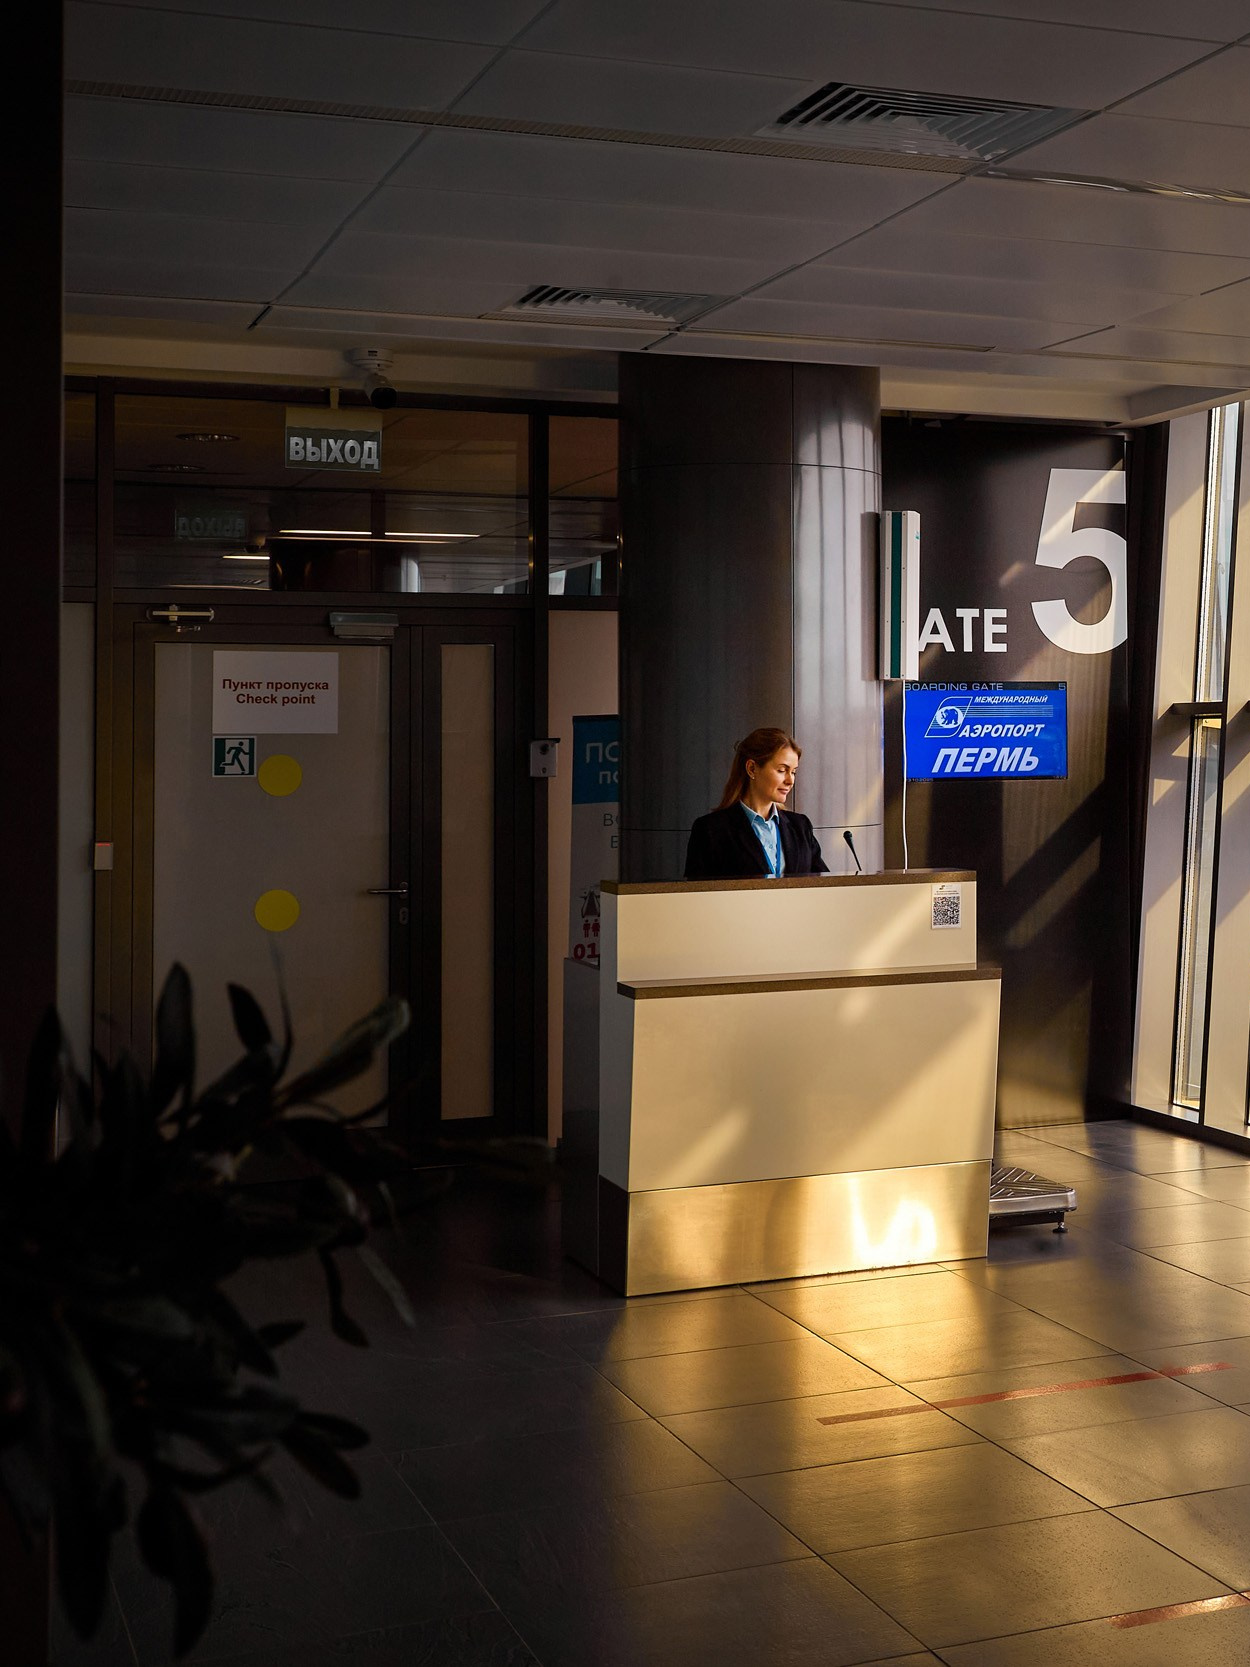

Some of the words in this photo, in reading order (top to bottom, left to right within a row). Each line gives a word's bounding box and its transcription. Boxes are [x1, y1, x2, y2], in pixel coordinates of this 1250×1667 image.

[289, 436, 379, 469] ВЫХОД
[1031, 468, 1129, 655] 5
[918, 607, 1008, 653] ATE
[222, 678, 263, 691] Пункт
[266, 681, 329, 692] пропуска
[905, 683, 968, 691] BOARDING
[972, 683, 1004, 691] GATE
[236, 693, 278, 704] Check
[281, 693, 316, 706] point
[974, 695, 1049, 704] МЕЖДУНАРОДНЫЙ
[958, 723, 1046, 738] АЭРОПОРТ
[931, 746, 1040, 774] ПЕРМЬ
